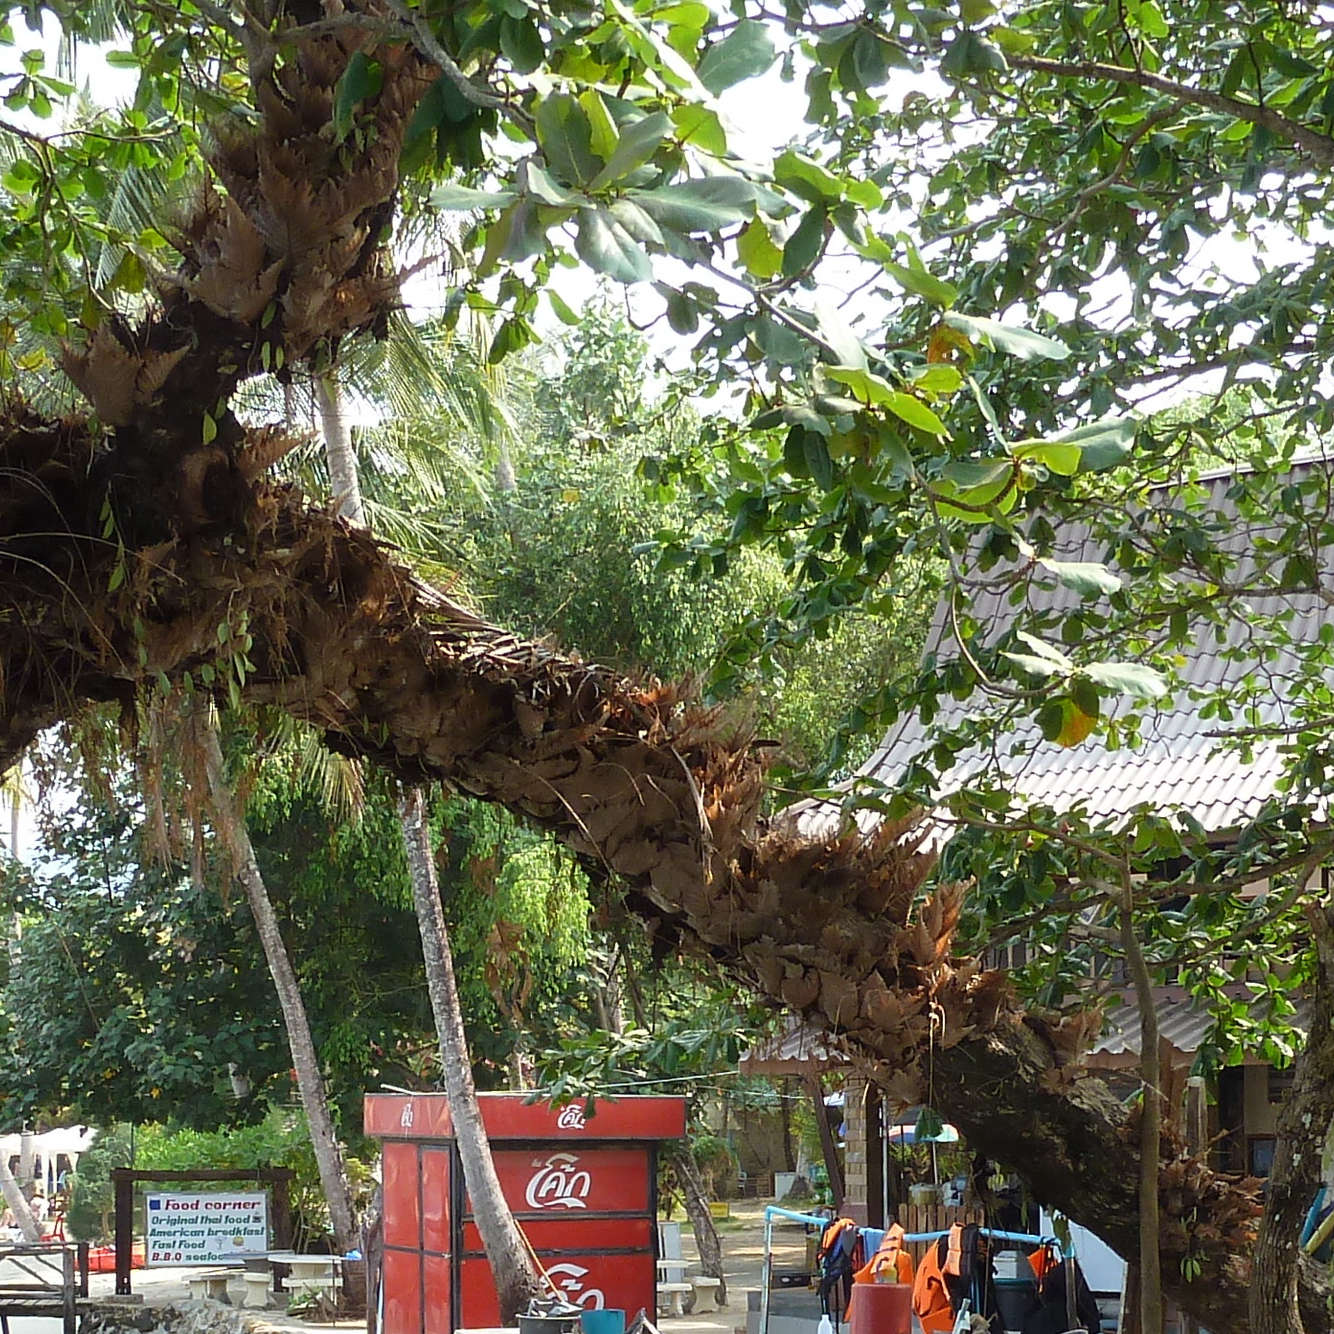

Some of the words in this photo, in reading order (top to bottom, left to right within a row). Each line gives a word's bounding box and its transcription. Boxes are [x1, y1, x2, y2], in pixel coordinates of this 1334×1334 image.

[165, 1199, 200, 1211] Food
[204, 1201, 261, 1211] corner
[151, 1215, 198, 1226] Original
[224, 1214, 250, 1224] food
[149, 1227, 205, 1237] American
[152, 1239, 176, 1249] Fast
[178, 1239, 206, 1249] Food
